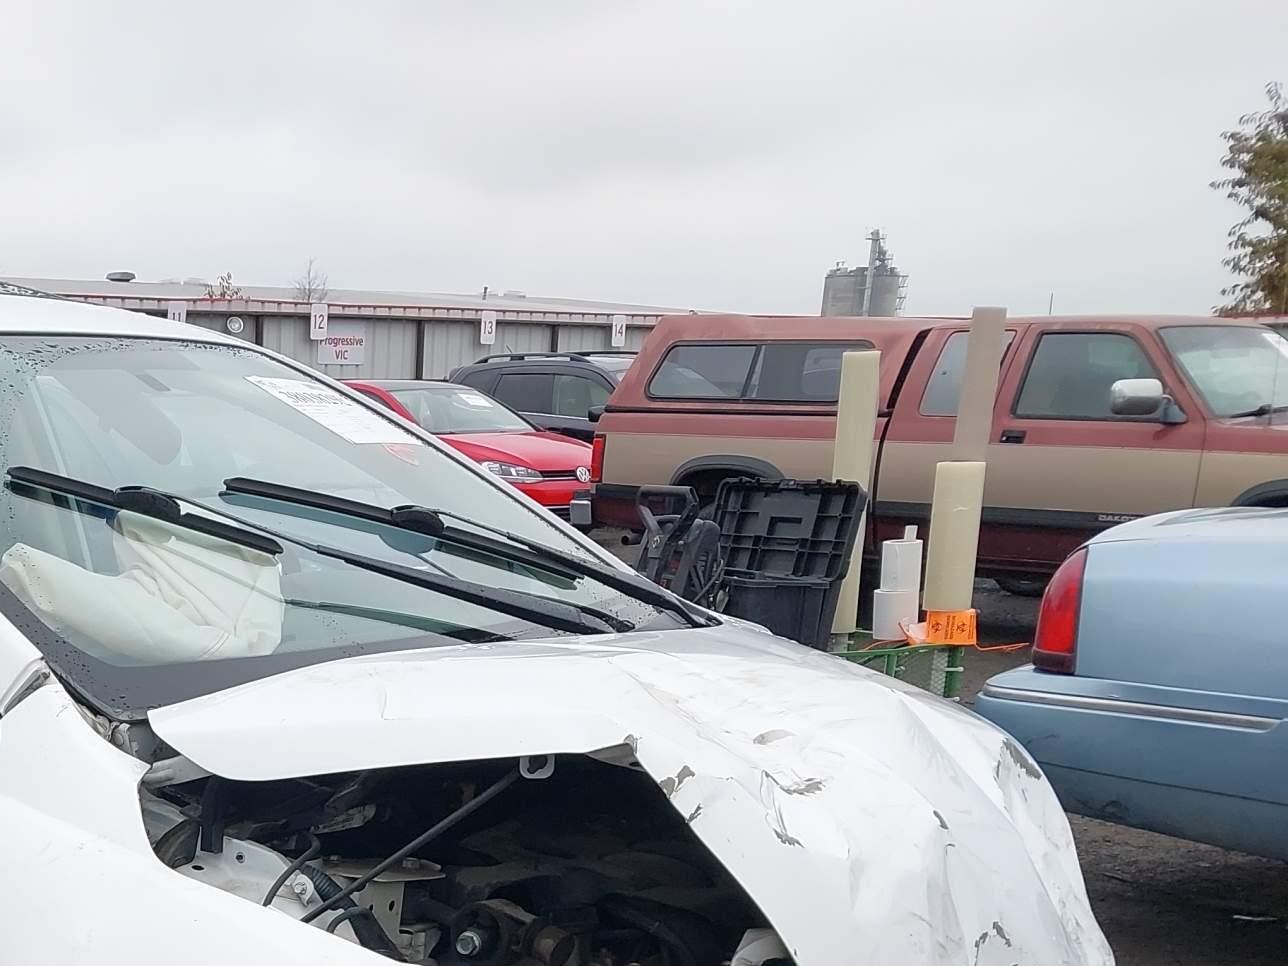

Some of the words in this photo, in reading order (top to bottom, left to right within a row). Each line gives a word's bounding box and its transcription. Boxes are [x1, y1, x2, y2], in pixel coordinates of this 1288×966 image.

[313, 314, 325, 330] 12
[483, 319, 494, 335] 13
[614, 323, 624, 337] 14
[334, 349, 349, 361] VIC
